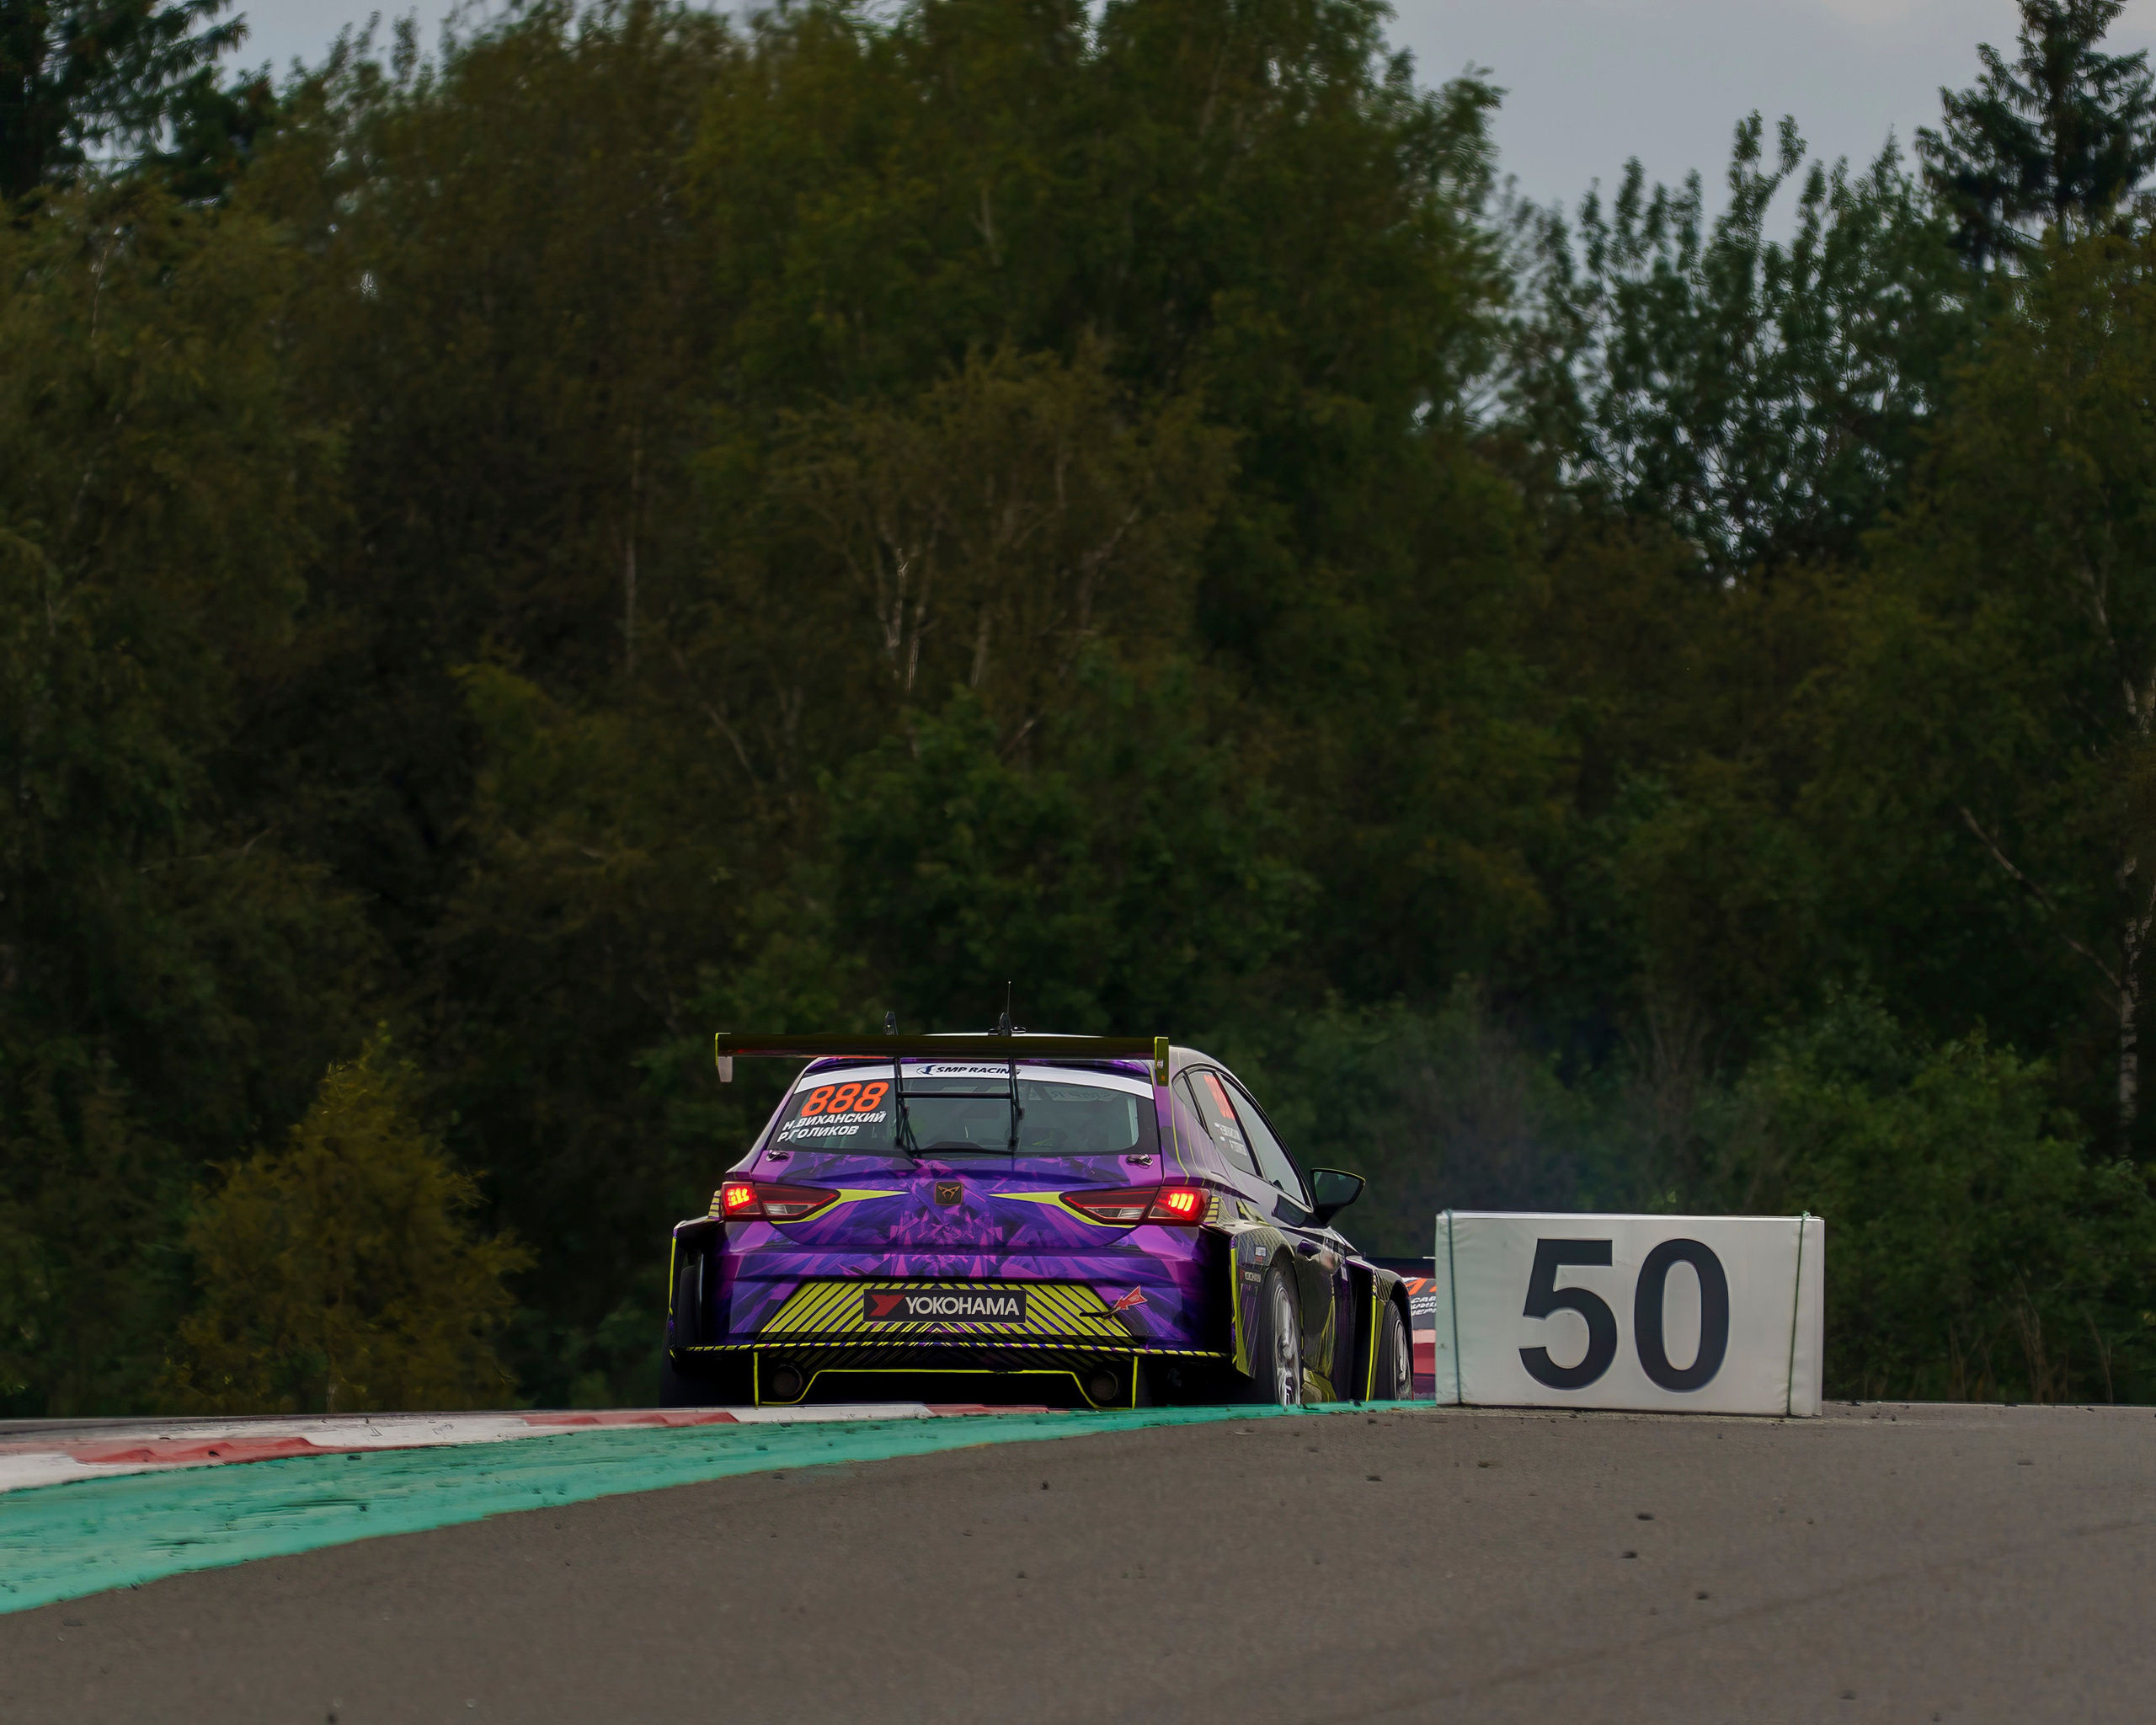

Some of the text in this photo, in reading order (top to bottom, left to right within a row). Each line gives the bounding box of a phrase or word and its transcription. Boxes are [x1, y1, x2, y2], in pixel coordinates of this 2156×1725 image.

[801, 1081, 890, 1118] 888
[905, 1296, 1020, 1316] YOKOHAMA
[1518, 1238, 1730, 1392] 50
